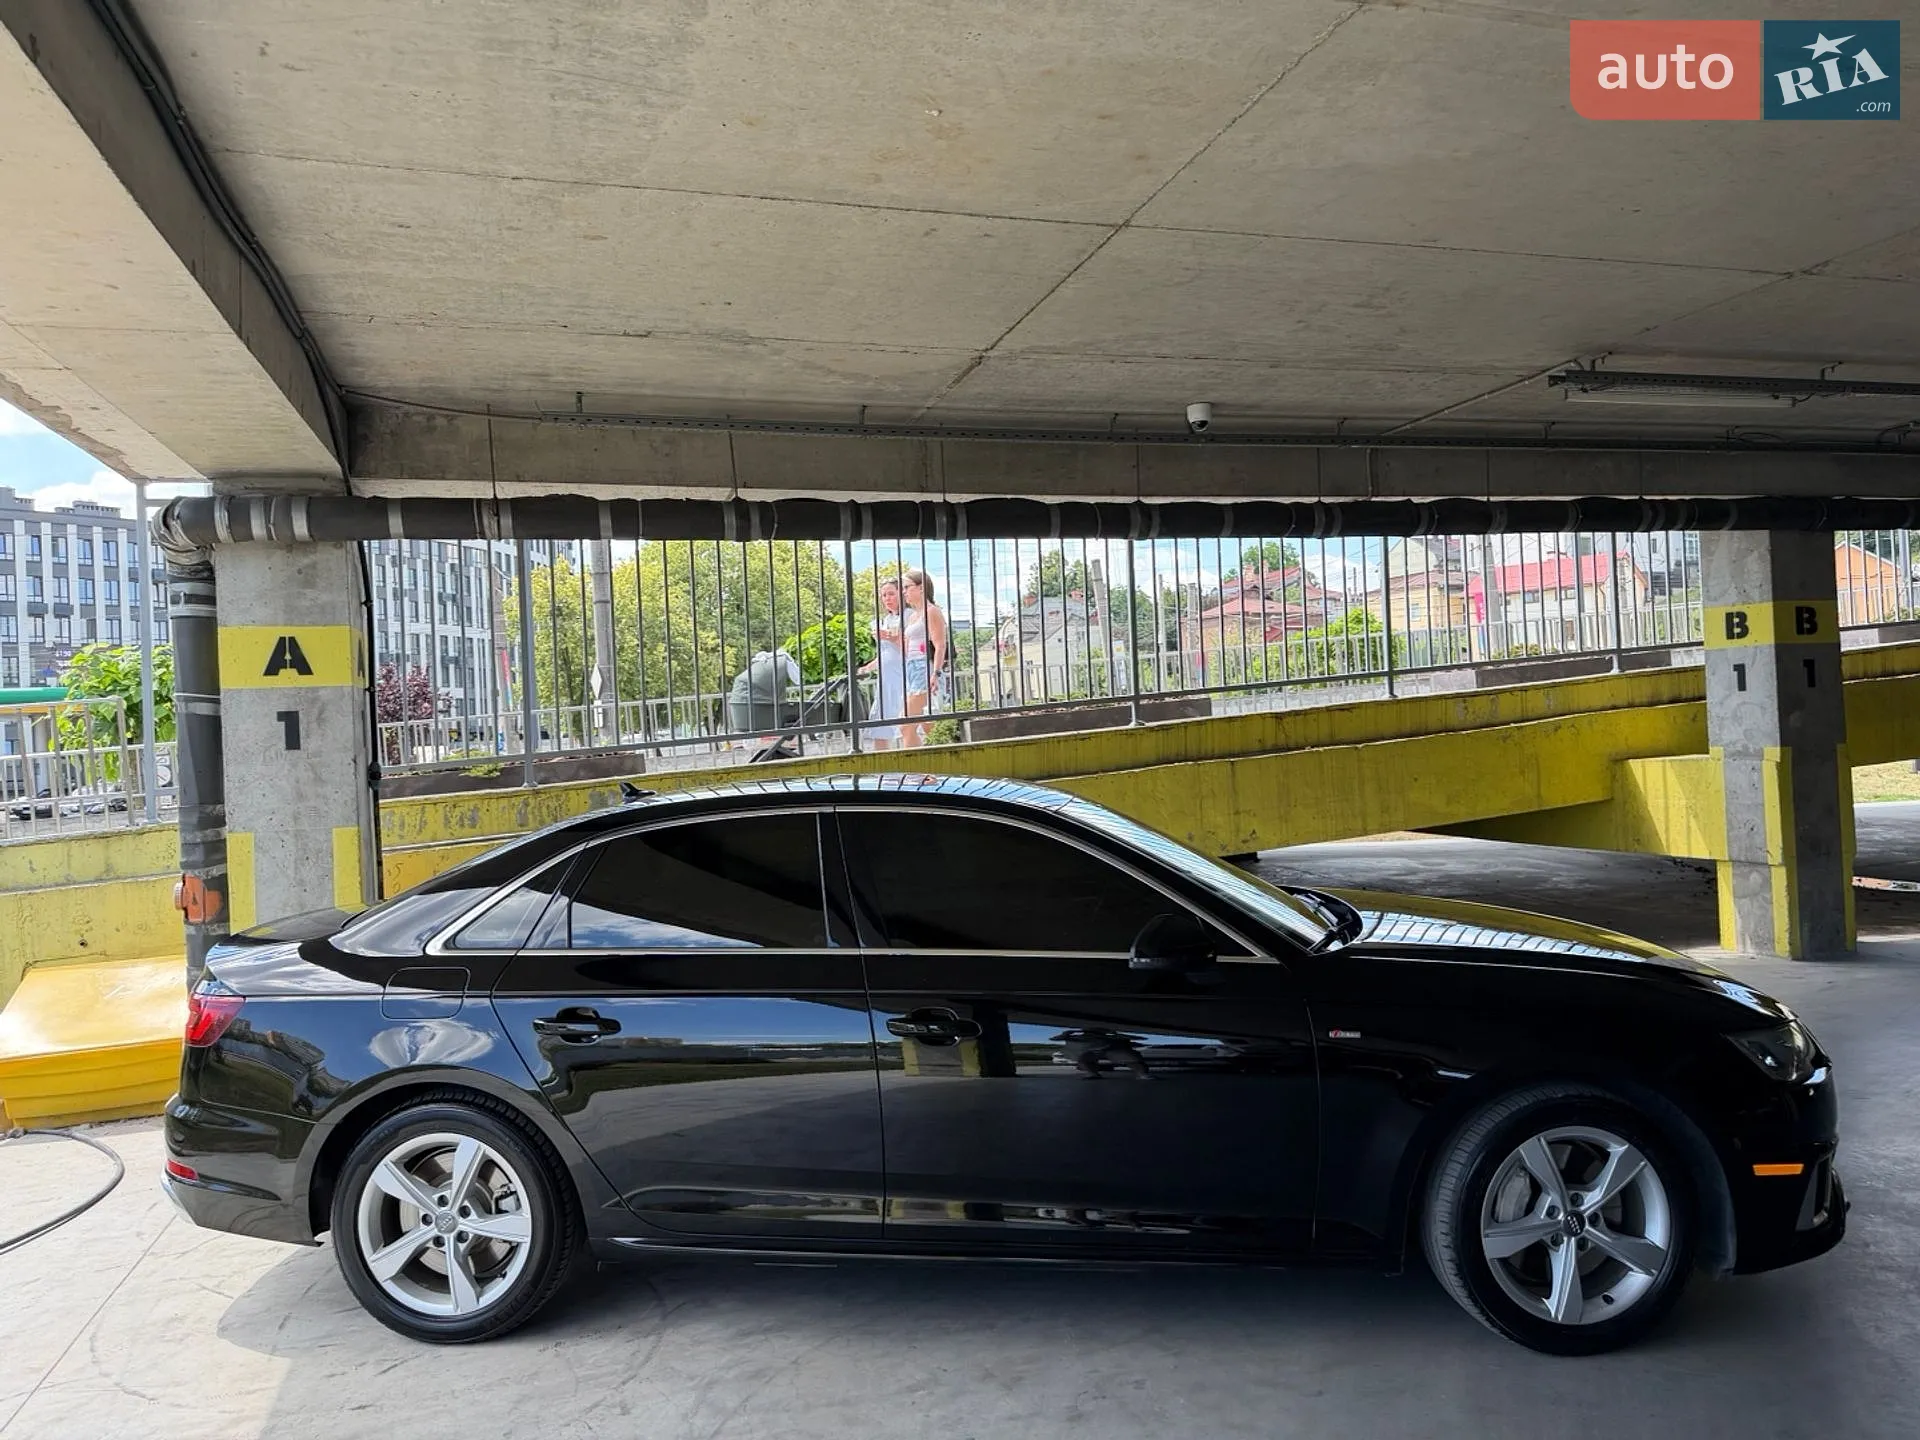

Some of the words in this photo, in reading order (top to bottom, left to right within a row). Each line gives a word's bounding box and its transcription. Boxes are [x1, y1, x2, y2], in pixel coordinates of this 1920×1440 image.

[1725, 611, 1749, 640] B
[1796, 606, 1818, 635] B
[263, 636, 314, 676] A
[1733, 663, 1747, 691] 1
[1803, 659, 1816, 687] 1
[277, 711, 301, 750] 1
